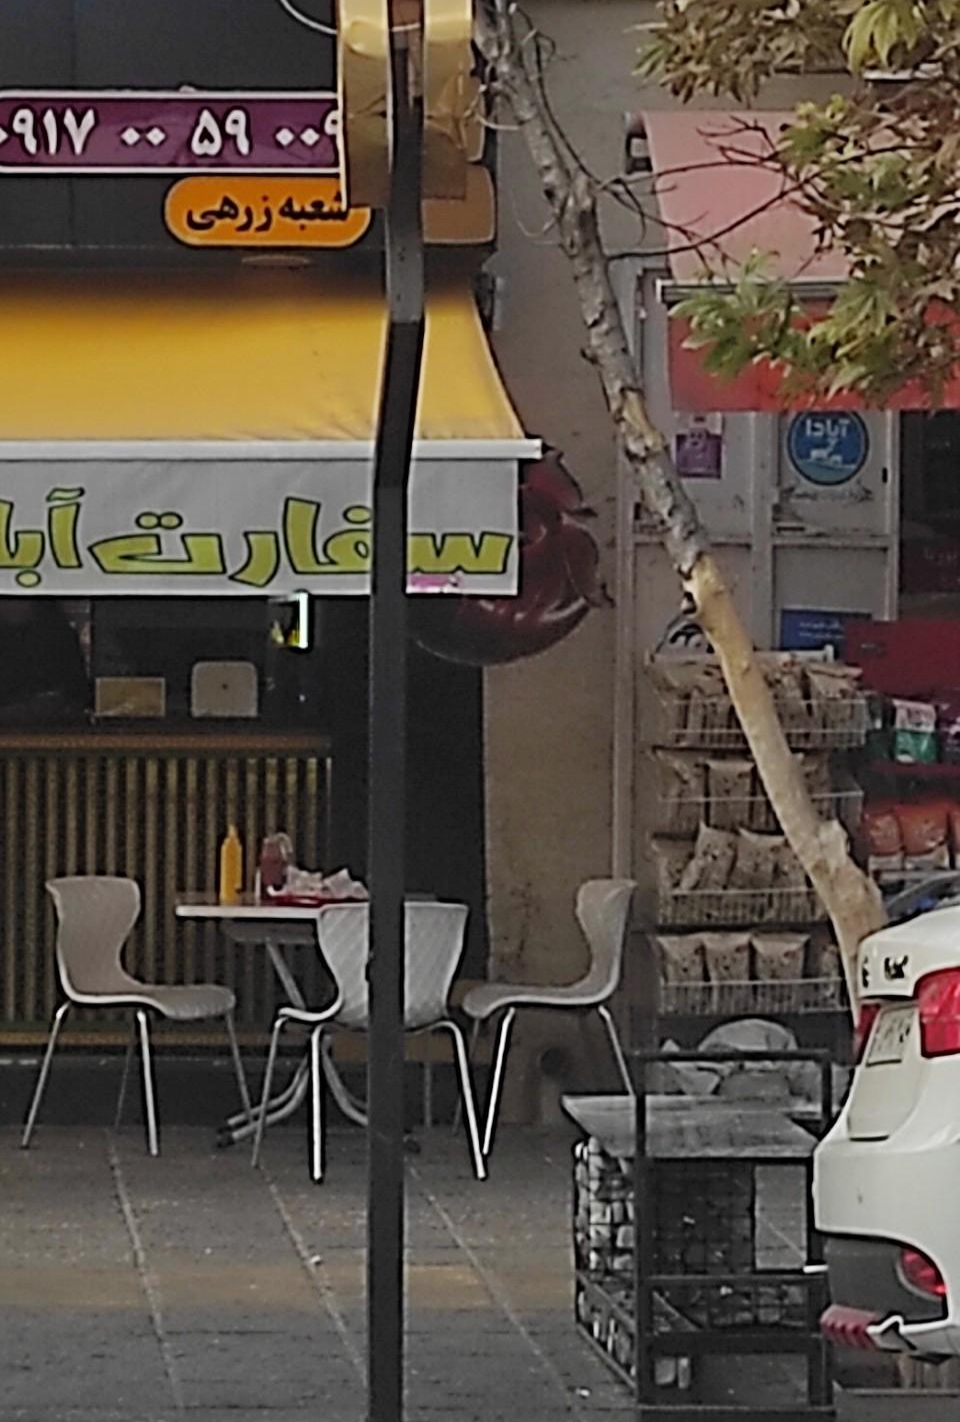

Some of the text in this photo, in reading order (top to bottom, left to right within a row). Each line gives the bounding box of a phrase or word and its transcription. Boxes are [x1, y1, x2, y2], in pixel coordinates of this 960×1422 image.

[120, 125, 167, 147] ۰۰
[190, 108, 252, 156] ۵۹
[186, 194, 273, 231] زرهی
[87, 496, 514, 588] سفارت
